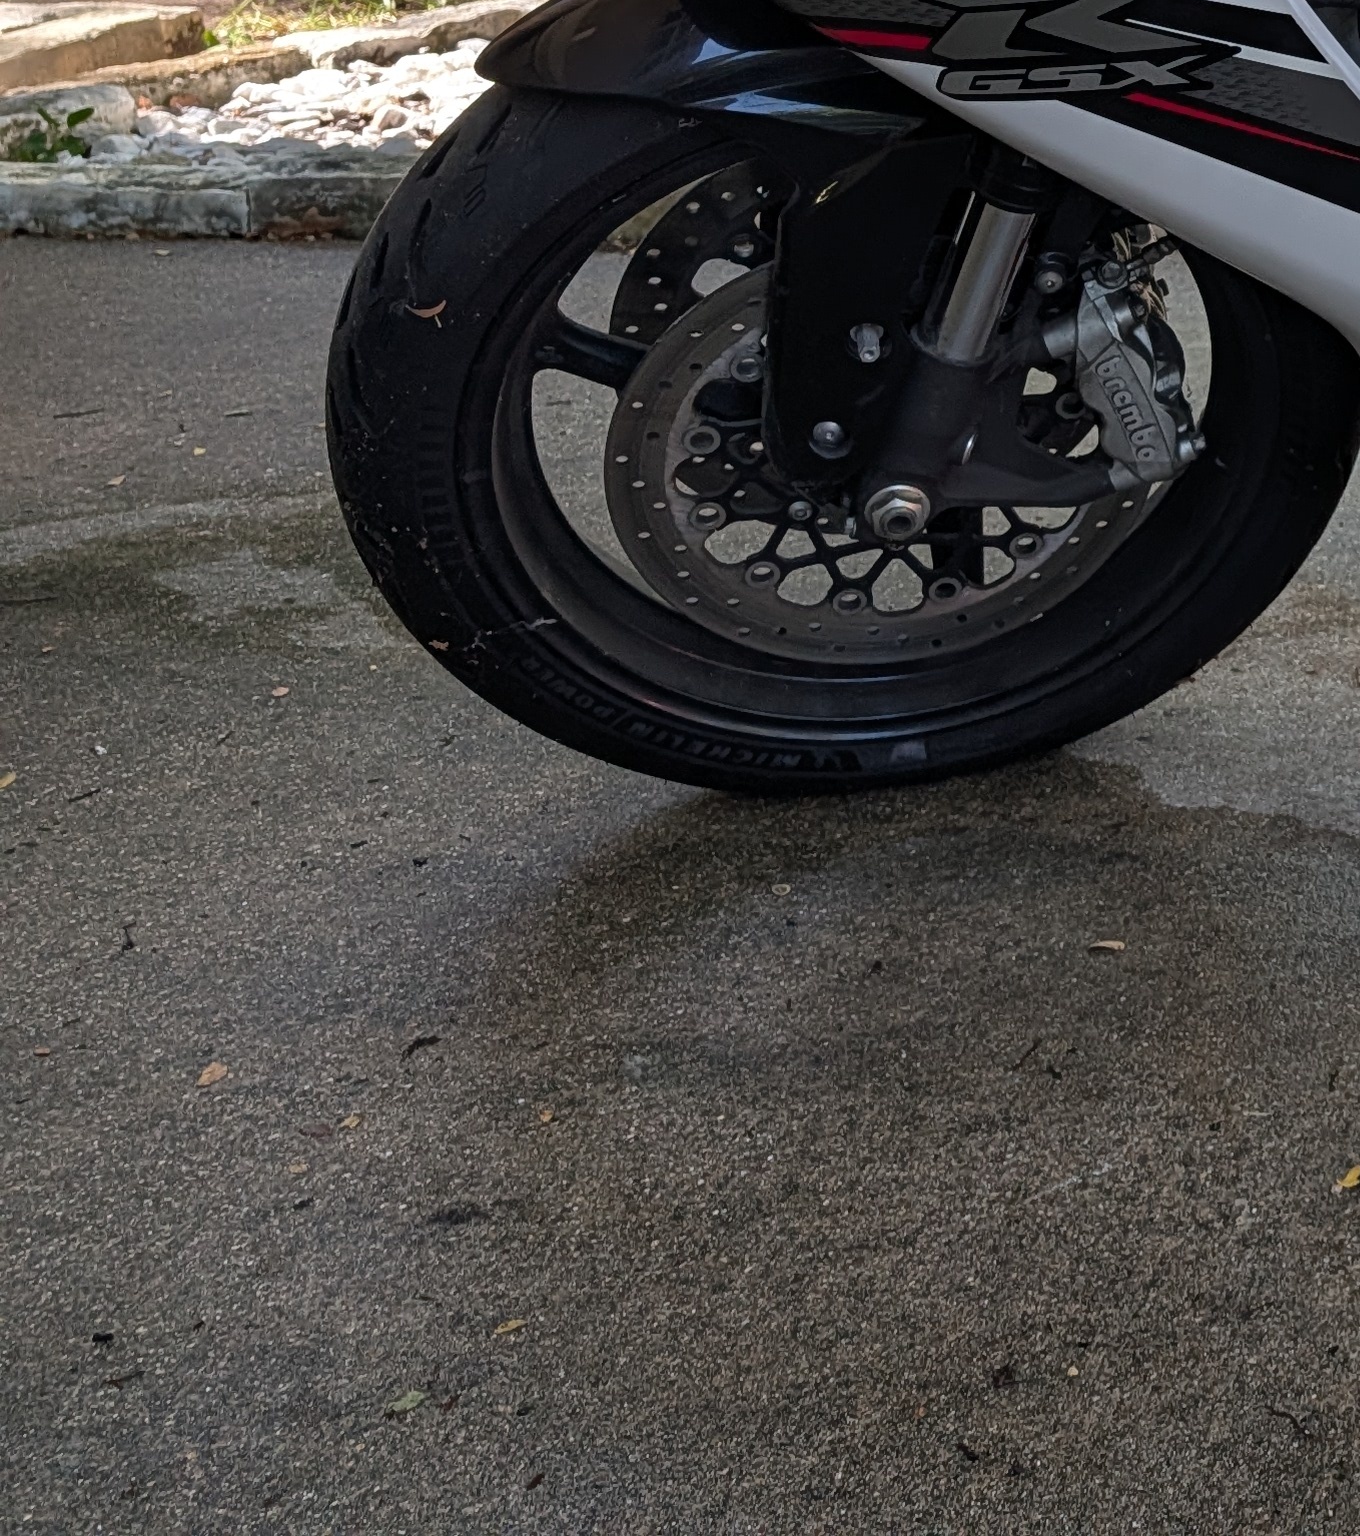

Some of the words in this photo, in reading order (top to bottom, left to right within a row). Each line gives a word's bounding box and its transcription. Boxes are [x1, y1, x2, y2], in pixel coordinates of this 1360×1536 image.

[941, 55, 1209, 95] GSX
[1095, 355, 1156, 460] brembo
[520, 658, 615, 718] POWER
[627, 721, 803, 767] MICHELIN
